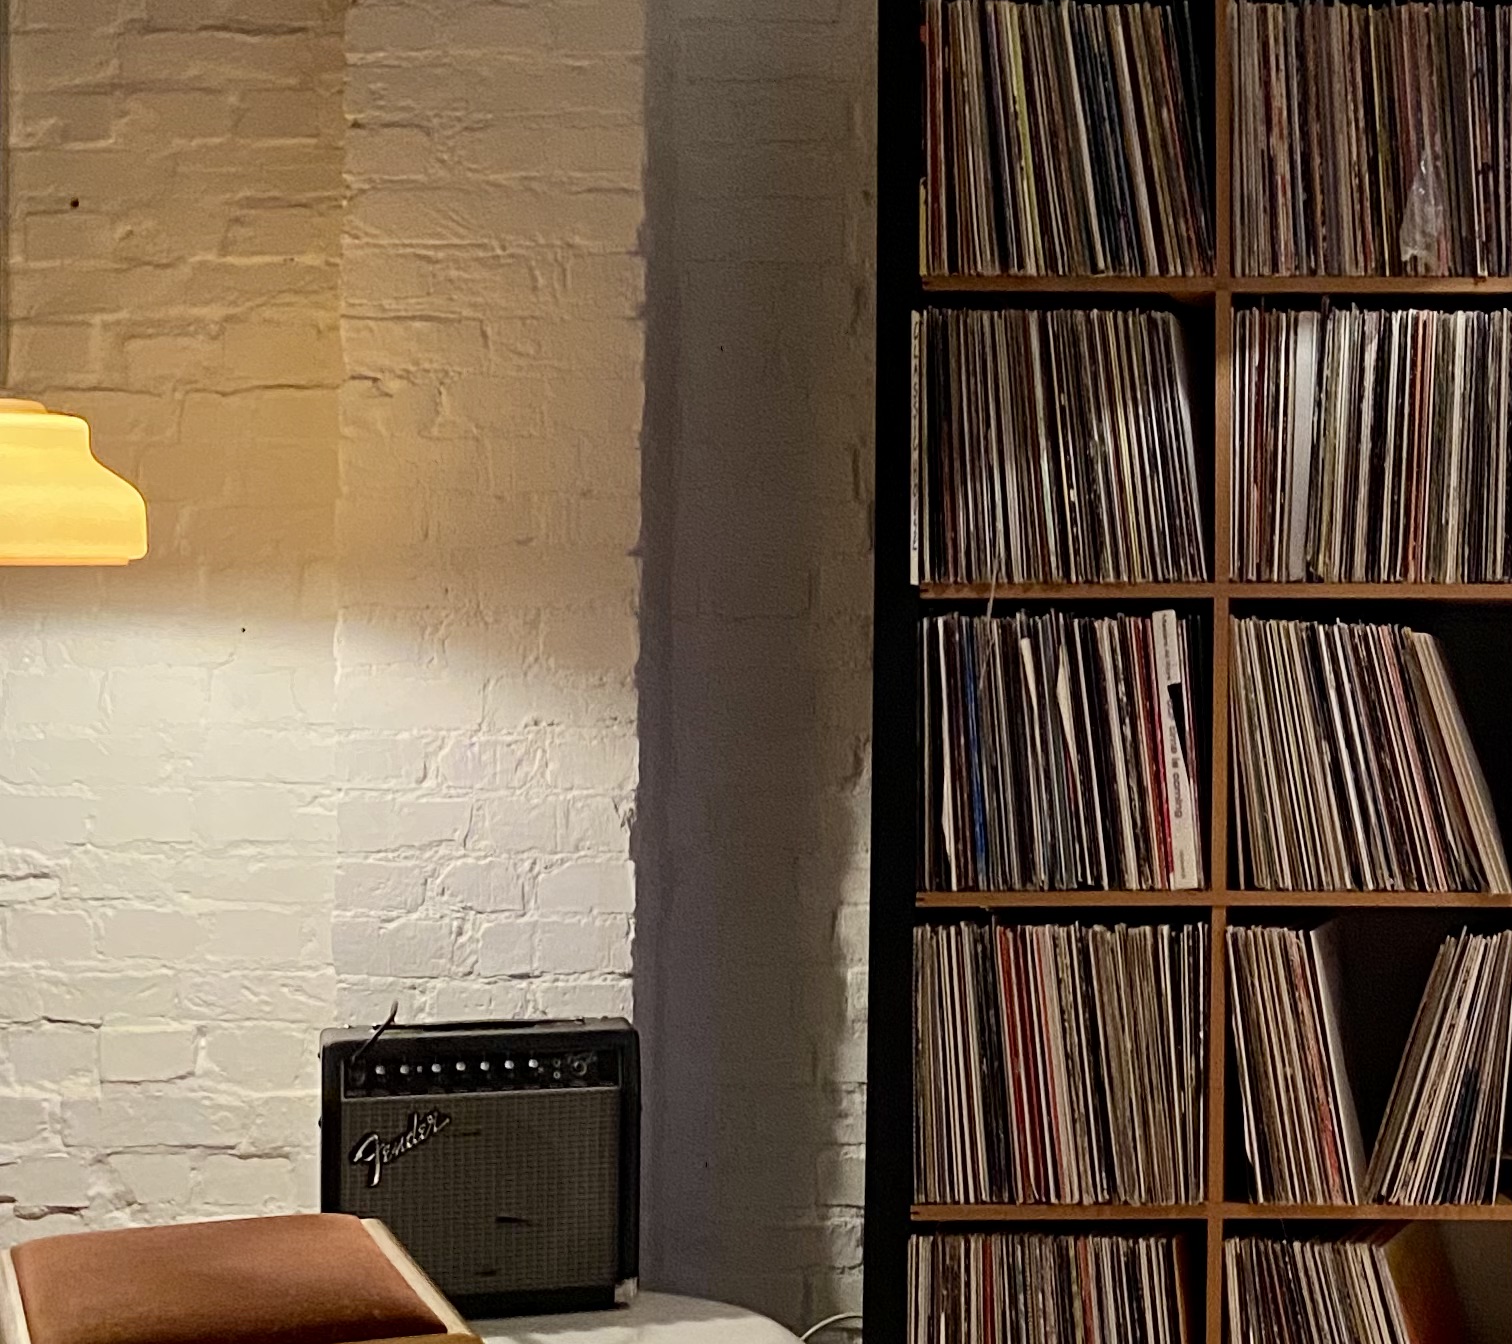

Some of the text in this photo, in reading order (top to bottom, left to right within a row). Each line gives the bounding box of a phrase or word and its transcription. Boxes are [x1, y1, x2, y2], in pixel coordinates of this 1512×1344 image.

[1171, 757, 1181, 768] is
[1173, 772, 1184, 818] coming
[353, 1110, 450, 1186] Fender
